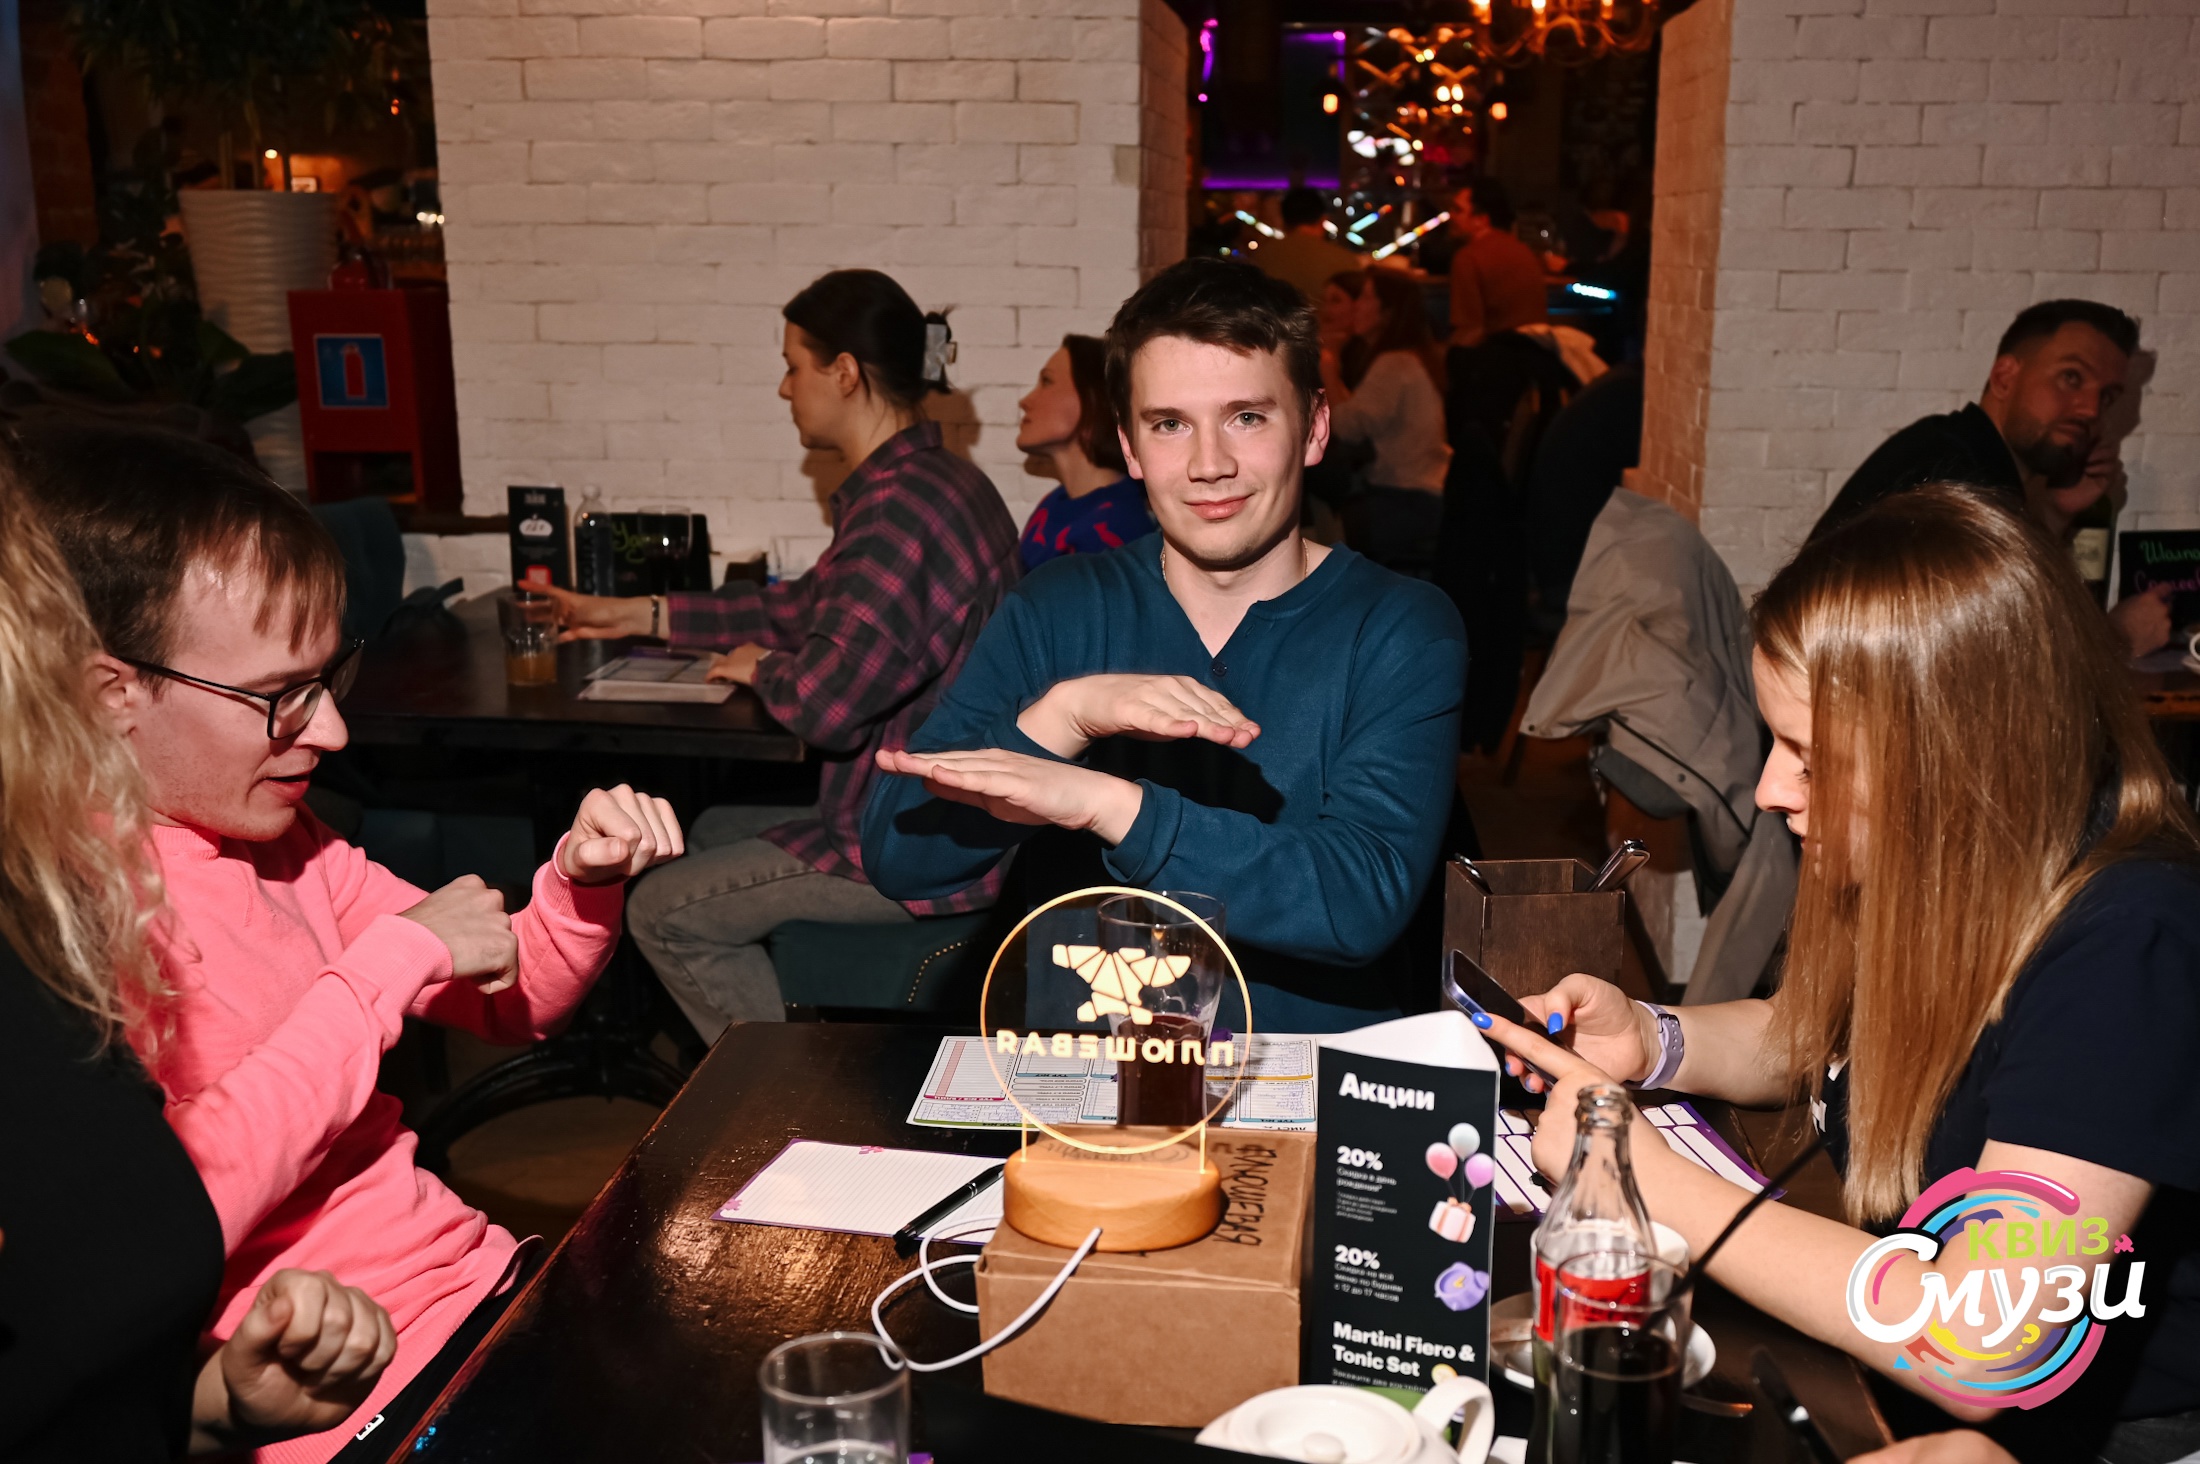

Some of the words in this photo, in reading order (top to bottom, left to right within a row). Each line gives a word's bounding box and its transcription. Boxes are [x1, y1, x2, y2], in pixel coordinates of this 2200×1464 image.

[1338, 1071, 1435, 1111] Акции
[1336, 1145, 1384, 1171] 20%
[1334, 1244, 1381, 1270] 20%
[1332, 1320, 1402, 1353] Martini
[1404, 1331, 1457, 1363] Fiero
[1458, 1344, 1476, 1363] &
[1332, 1343, 1385, 1371] Tonic
[1386, 1354, 1421, 1378] Set
